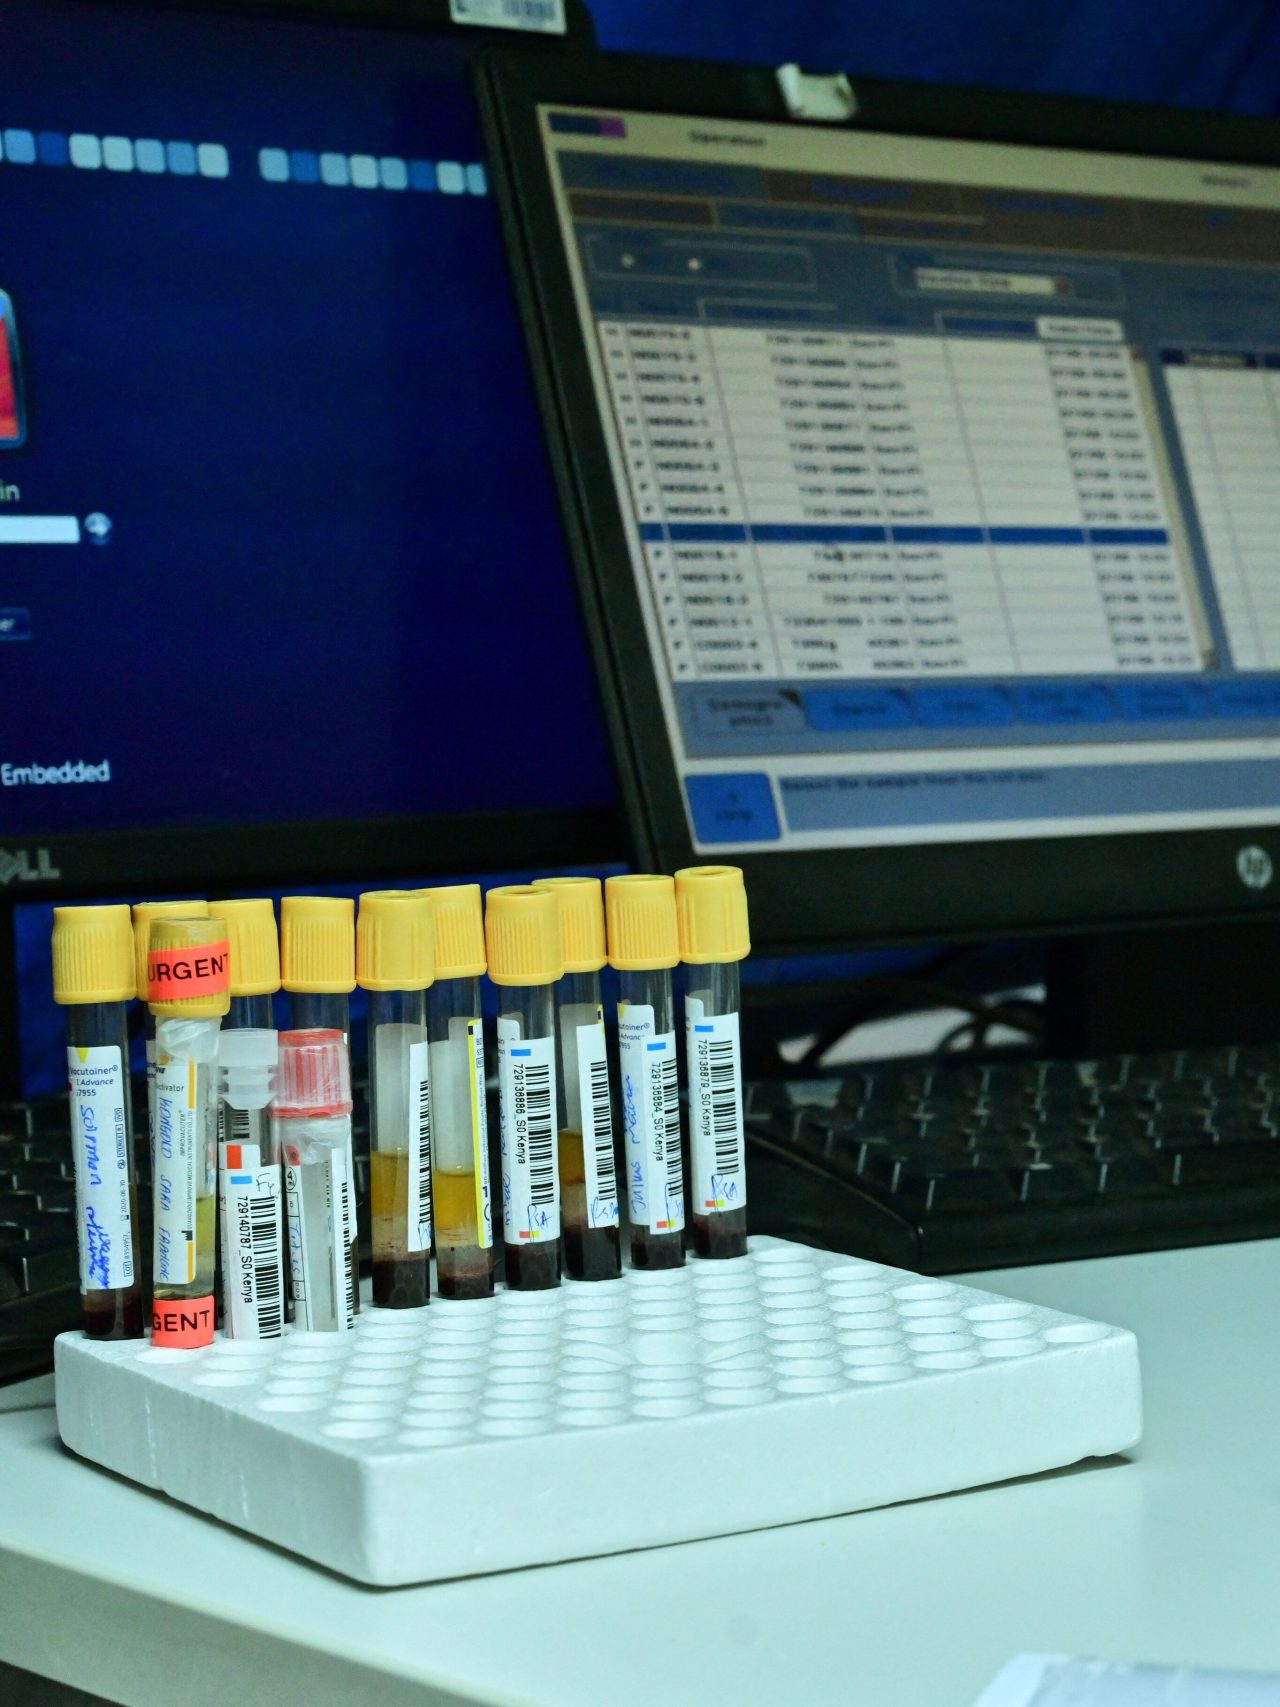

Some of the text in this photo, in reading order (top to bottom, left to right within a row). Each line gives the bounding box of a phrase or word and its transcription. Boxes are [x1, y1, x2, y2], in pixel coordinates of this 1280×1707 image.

[0, 479, 20, 502] in
[1, 758, 110, 786] Embedded
[0, 849, 60, 883] ELL
[76, 1088, 97, 1097] 7955
[80, 1078, 114, 1087] Advance
[701, 1108, 712, 1137] Kenya
[515, 1136, 526, 1165] Kenya
[655, 1136, 666, 1162] Kenya
[237, 1195, 253, 1304] 729140787_S0 Kenya
